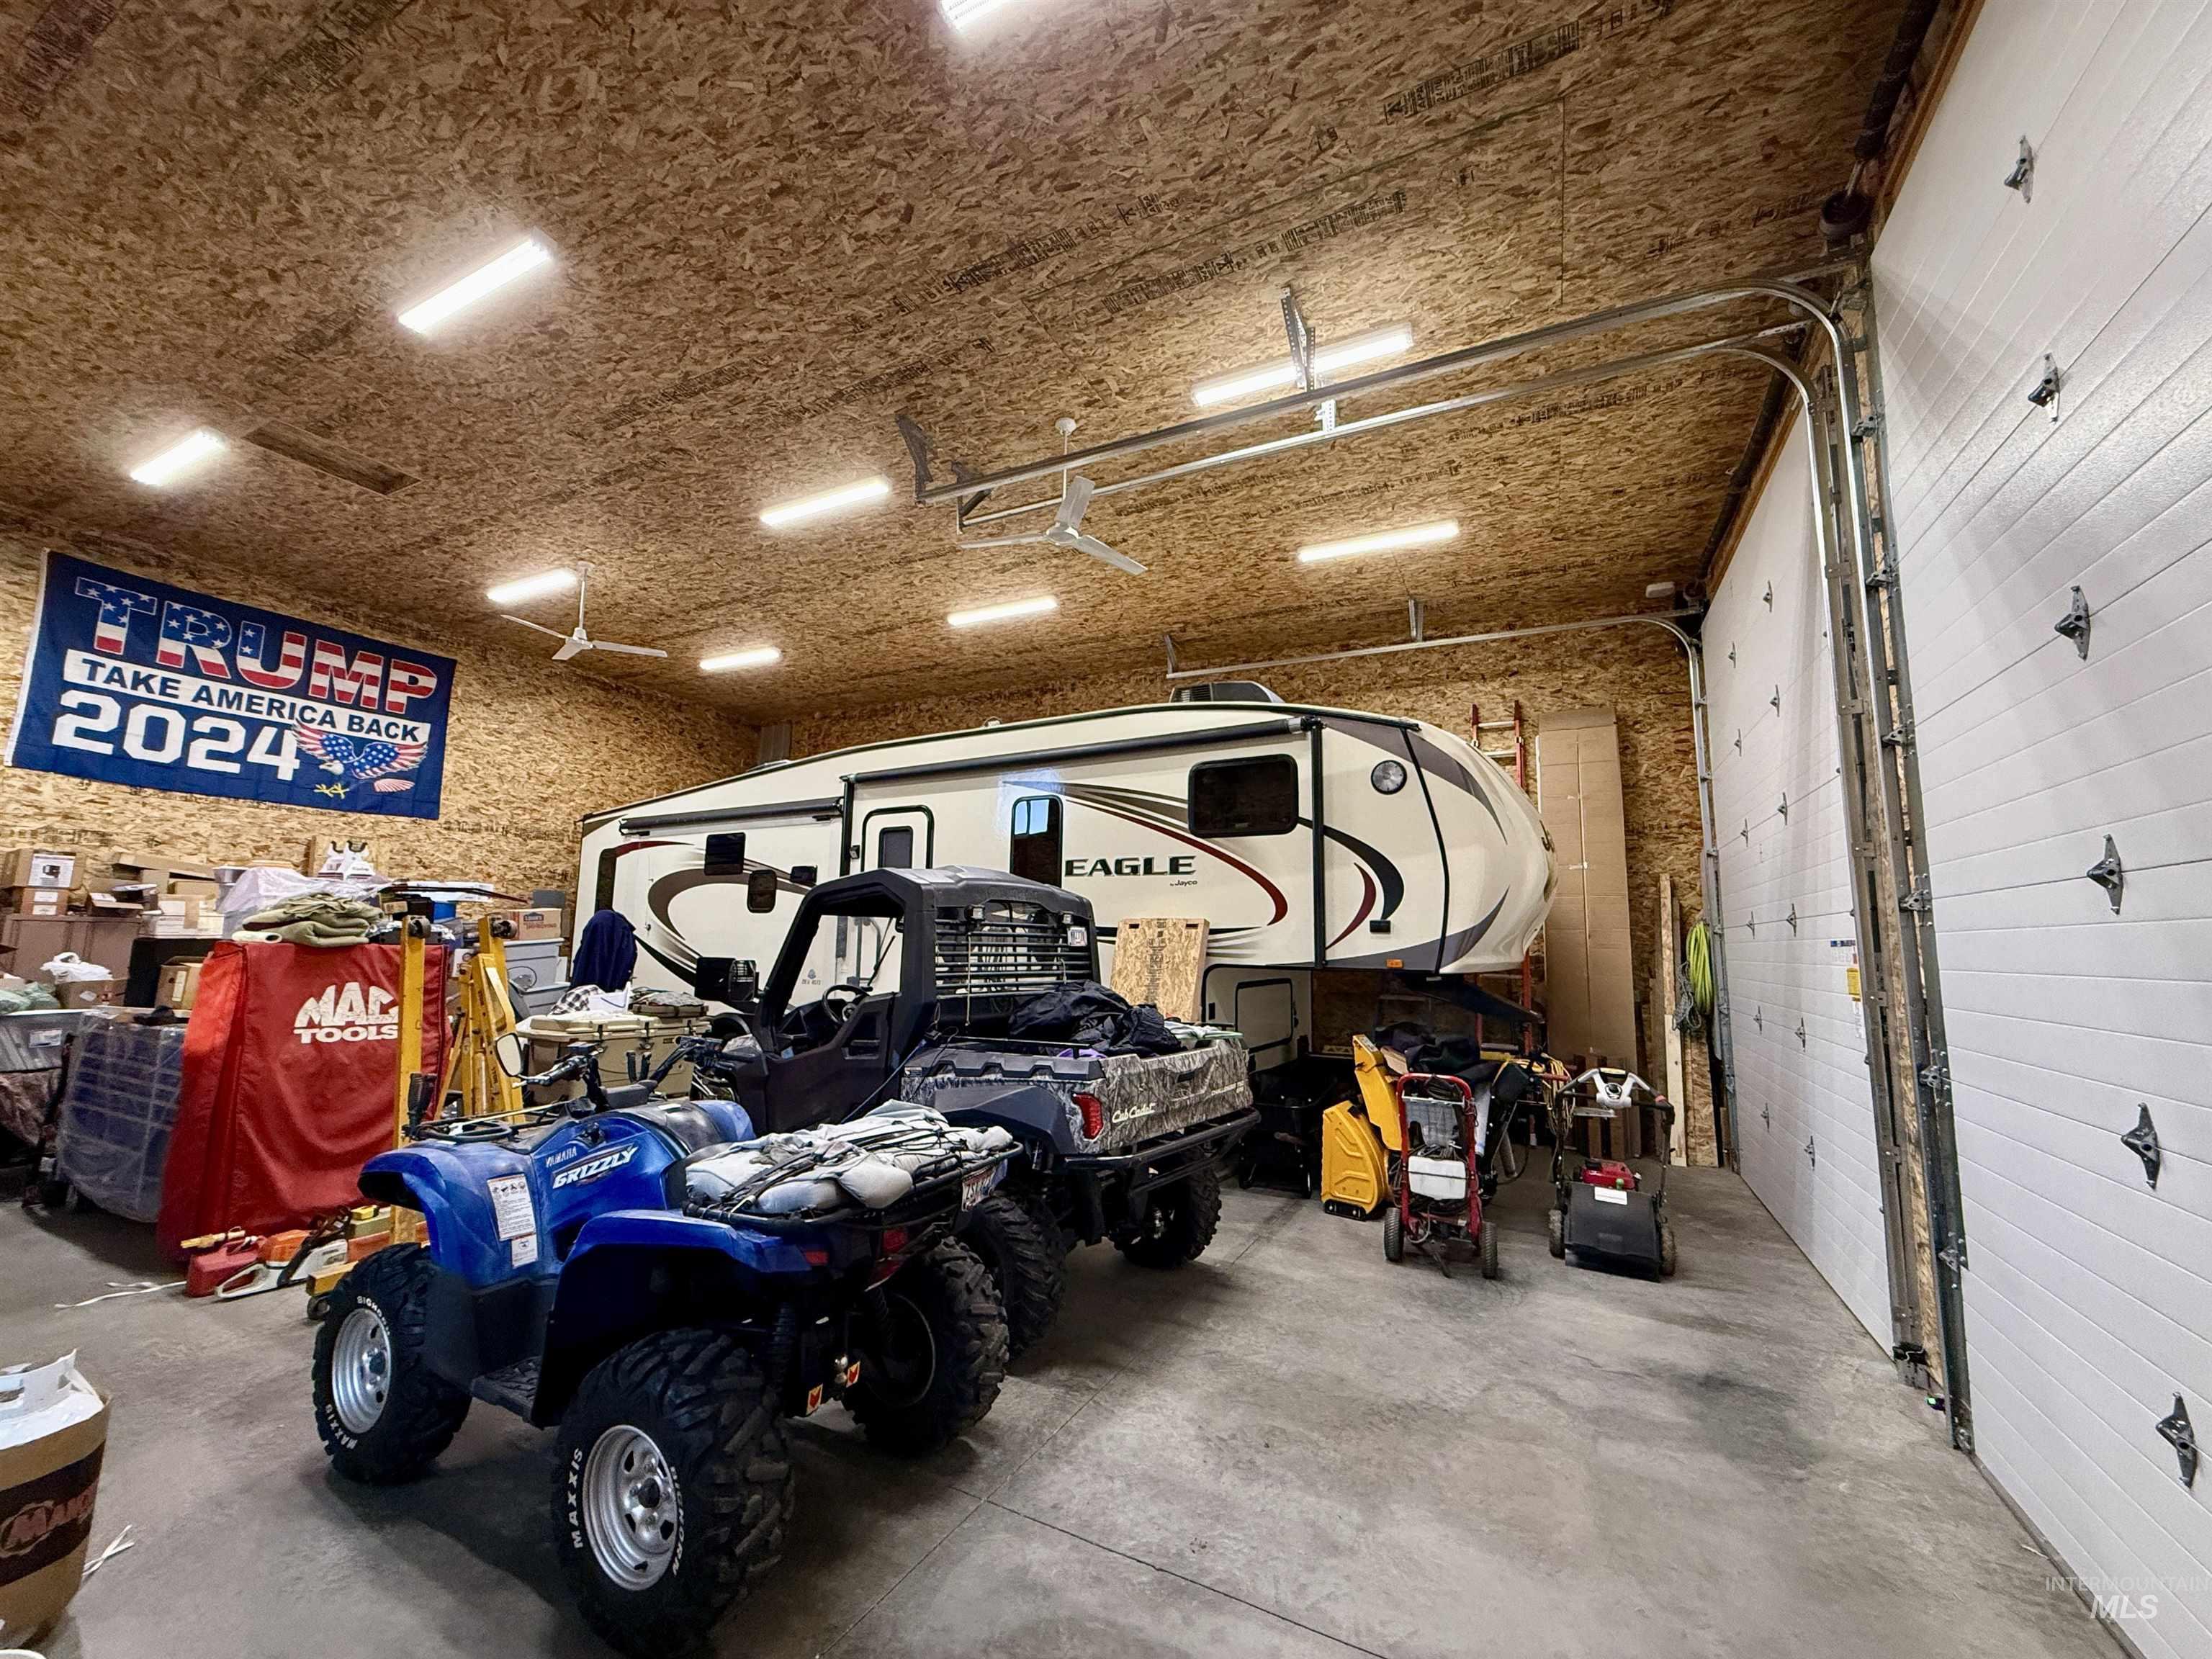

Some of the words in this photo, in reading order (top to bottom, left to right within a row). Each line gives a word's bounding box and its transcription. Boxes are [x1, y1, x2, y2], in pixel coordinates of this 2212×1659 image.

[75, 577, 437, 714] TRUMP
[81, 658, 184, 700] TAKE
[192, 685, 338, 730] AMERICA
[347, 714, 421, 743] BACK
[52, 689, 301, 781] 2024
[1064, 855, 1197, 877] EAGLE
[294, 981, 399, 1028] MAC
[293, 1025, 398, 1044] TOOLS
[1112, 1108, 1128, 1123] Cub
[1129, 1102, 1156, 1119] Cadet
[546, 1146, 577, 1167] YAMAHA
[552, 1146, 639, 1190] GRIZZLY
[325, 1403, 358, 1449] MAXXIS
[567, 1447, 584, 1548] MAXXIS
